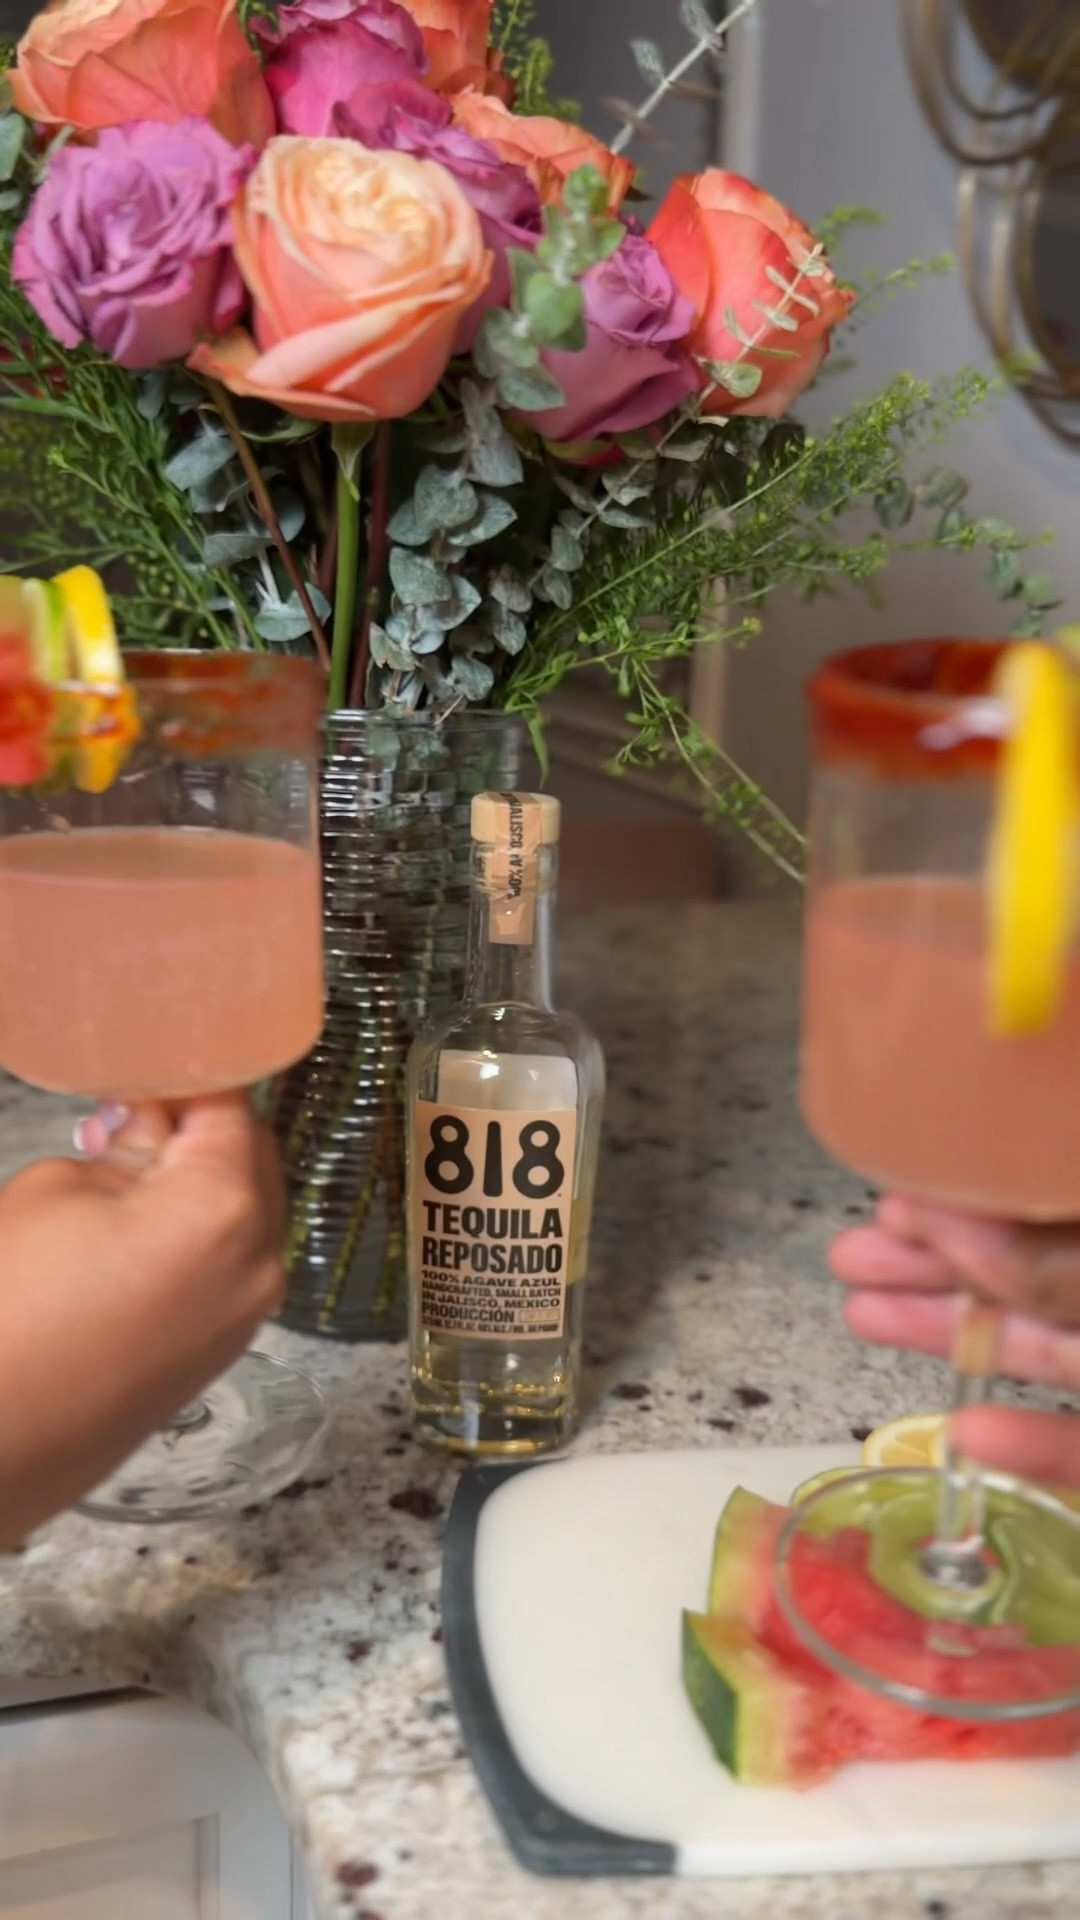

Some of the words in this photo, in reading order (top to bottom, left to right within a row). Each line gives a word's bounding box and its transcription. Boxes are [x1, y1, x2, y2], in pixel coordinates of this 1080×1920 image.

[424, 1114, 565, 1199] 818
[422, 1200, 563, 1239] TEQUILA
[422, 1236, 563, 1274] REPOSADO
[422, 1269, 460, 1284] 100%
[463, 1275, 517, 1287] AGAVE
[520, 1277, 561, 1287] AZUL
[422, 1290, 436, 1301] IN
[504, 1298, 560, 1308] MEXICO
[495, 1287, 527, 1298] SMALL
[529, 1287, 561, 1297] BATCH
